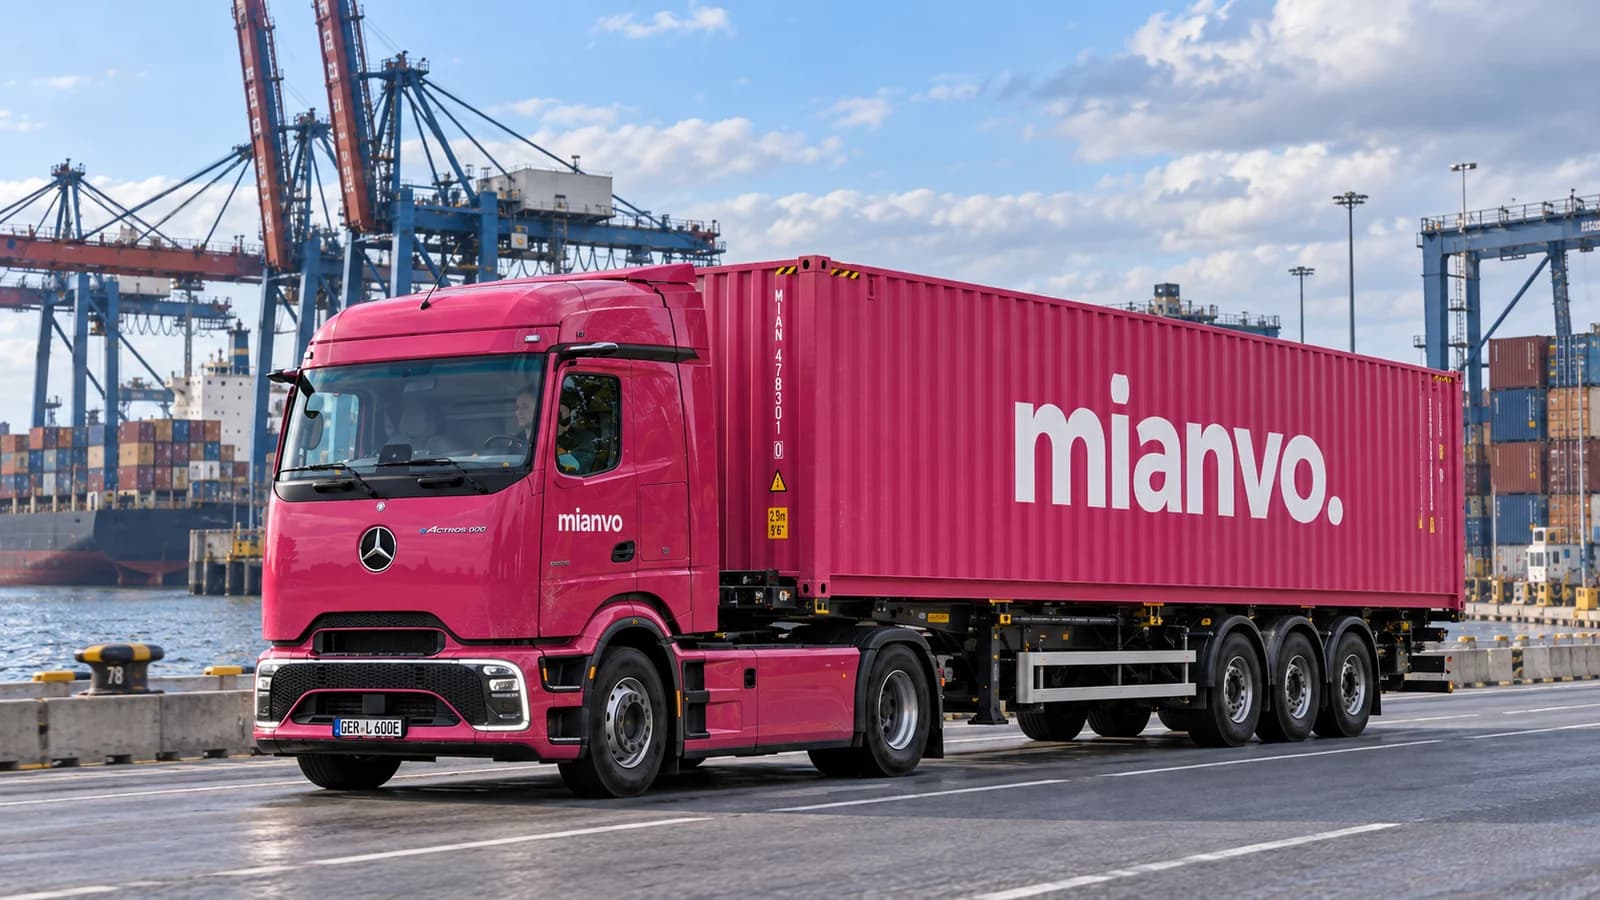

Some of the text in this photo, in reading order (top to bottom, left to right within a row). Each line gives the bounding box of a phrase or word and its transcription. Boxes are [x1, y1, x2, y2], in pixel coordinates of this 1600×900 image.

[775, 289, 784, 341] MIAN
[775, 348, 783, 435] 478301
[1014, 373, 1344, 526] mianvo.
[558, 507, 623, 533] mianvo
[106, 666, 124, 684] 78
[341, 720, 400, 735] GER L 600E
